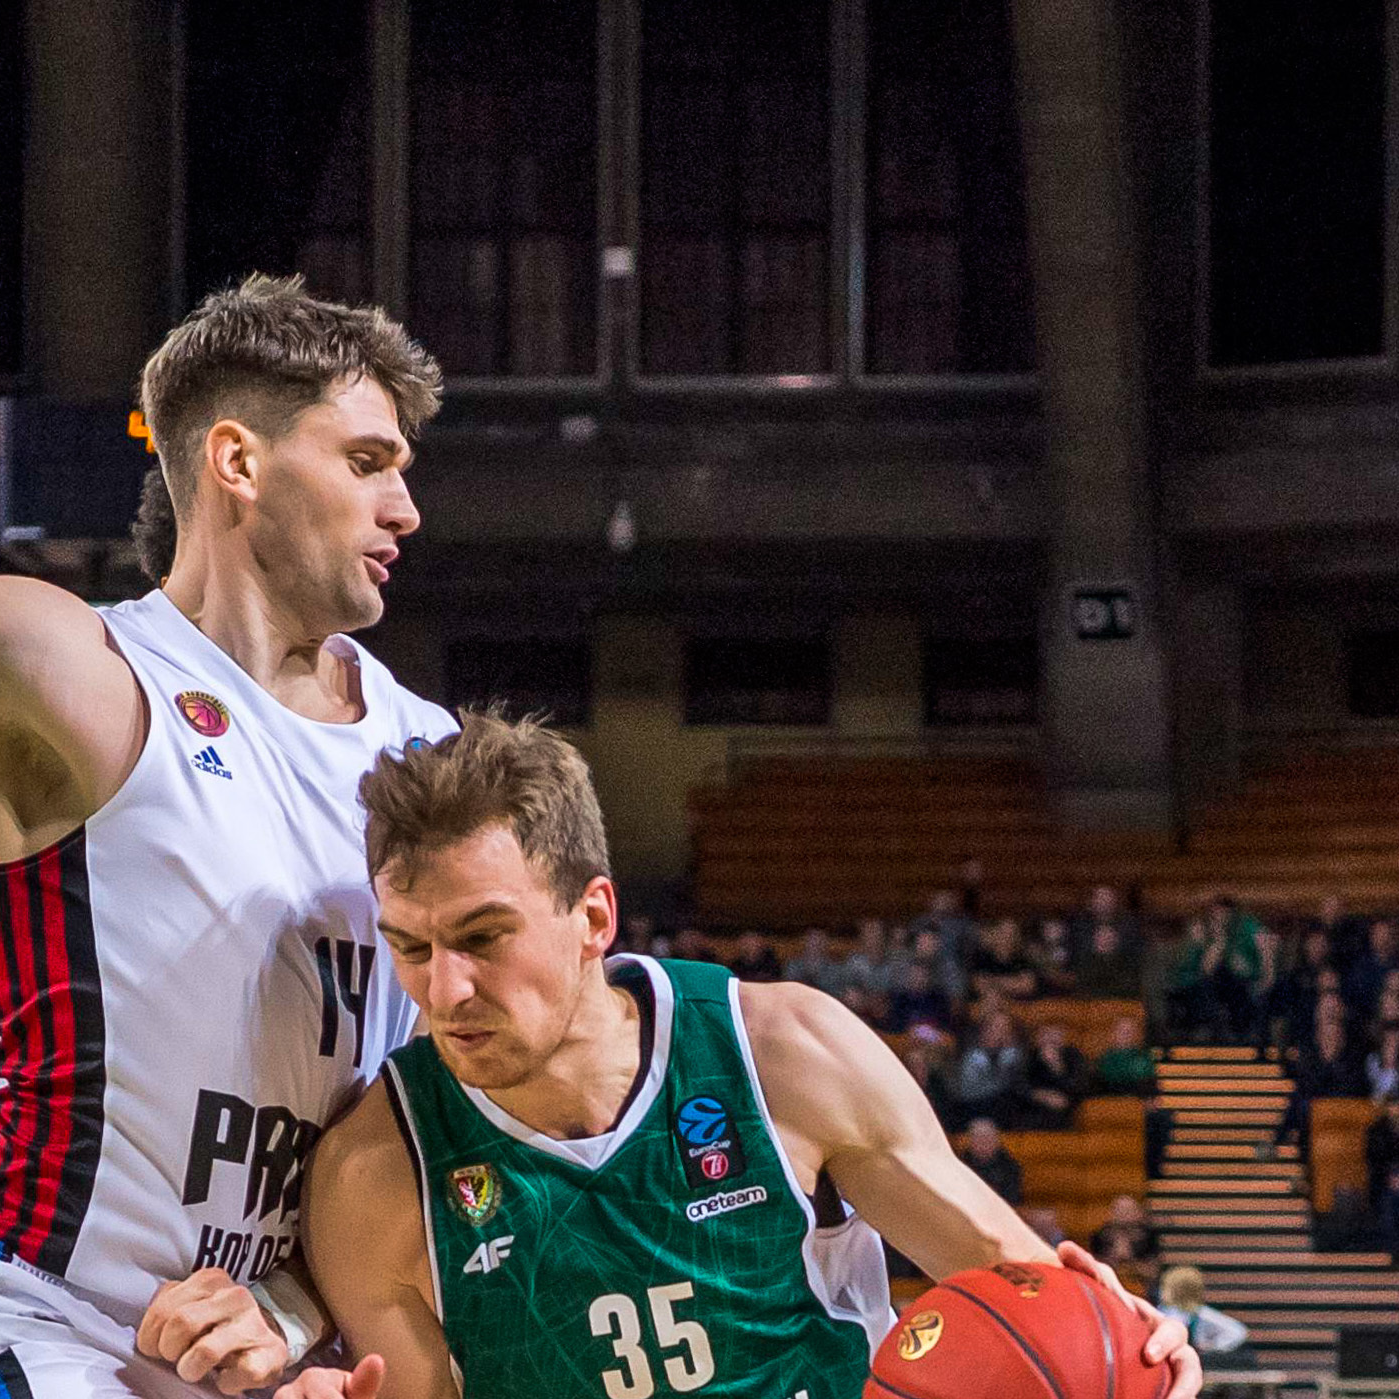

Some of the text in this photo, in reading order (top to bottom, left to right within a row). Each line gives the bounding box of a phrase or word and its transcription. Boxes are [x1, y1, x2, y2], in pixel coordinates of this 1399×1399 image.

[191, 760, 233, 780] adidas
[314, 936, 377, 1068] 14
[182, 1088, 323, 1226] PAR
[689, 1140, 731, 1158] EuroCup
[463, 1235, 515, 1274] 4F
